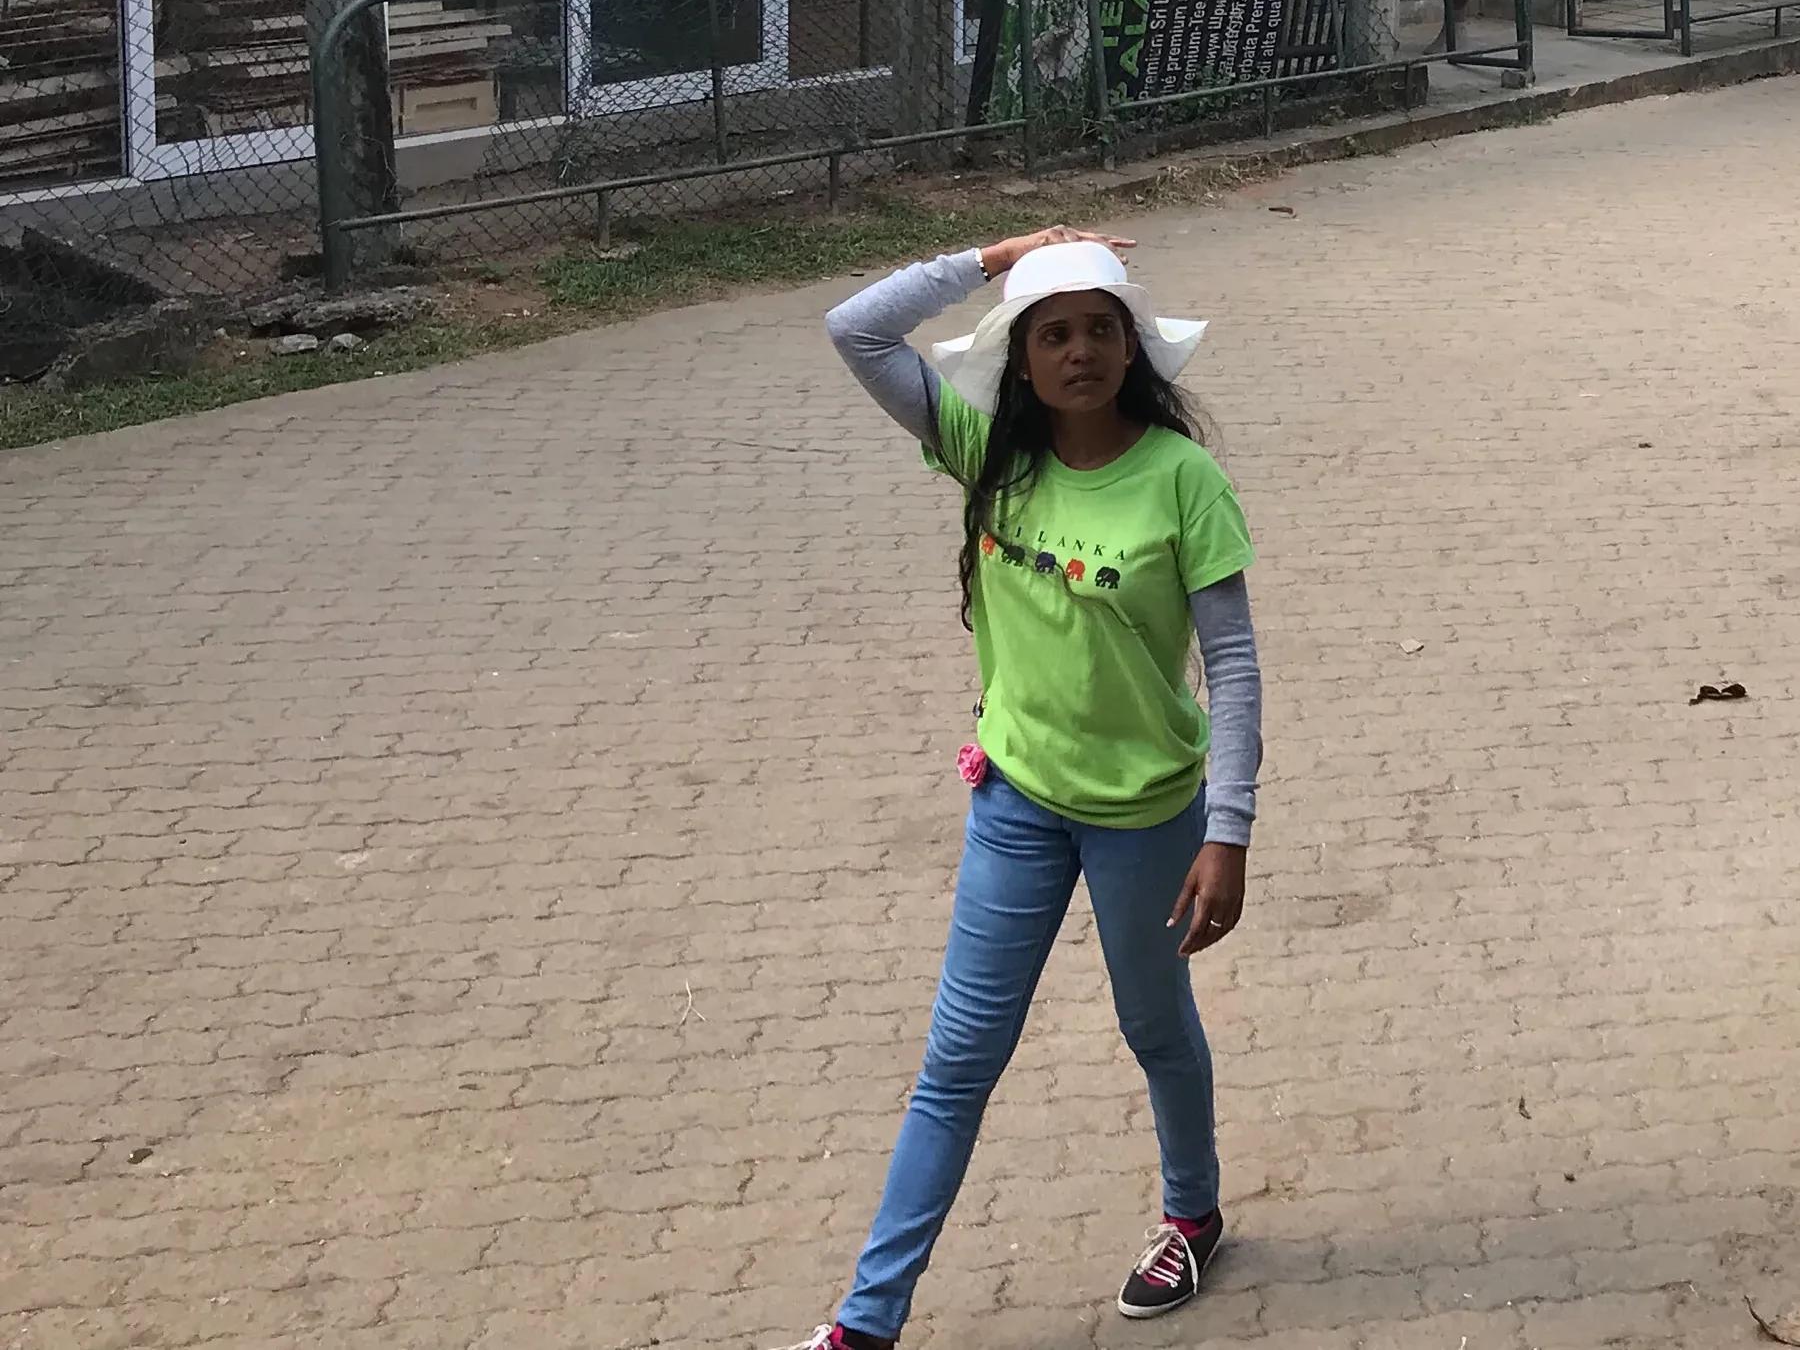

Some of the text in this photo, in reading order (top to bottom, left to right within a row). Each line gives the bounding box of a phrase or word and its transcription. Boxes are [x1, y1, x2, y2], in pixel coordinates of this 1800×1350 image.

[1150, 8, 1168, 30] Sri
[1165, 6, 1188, 72] premium
[1260, 31, 1277, 57] alta
[1038, 530, 1125, 561] LANKA
